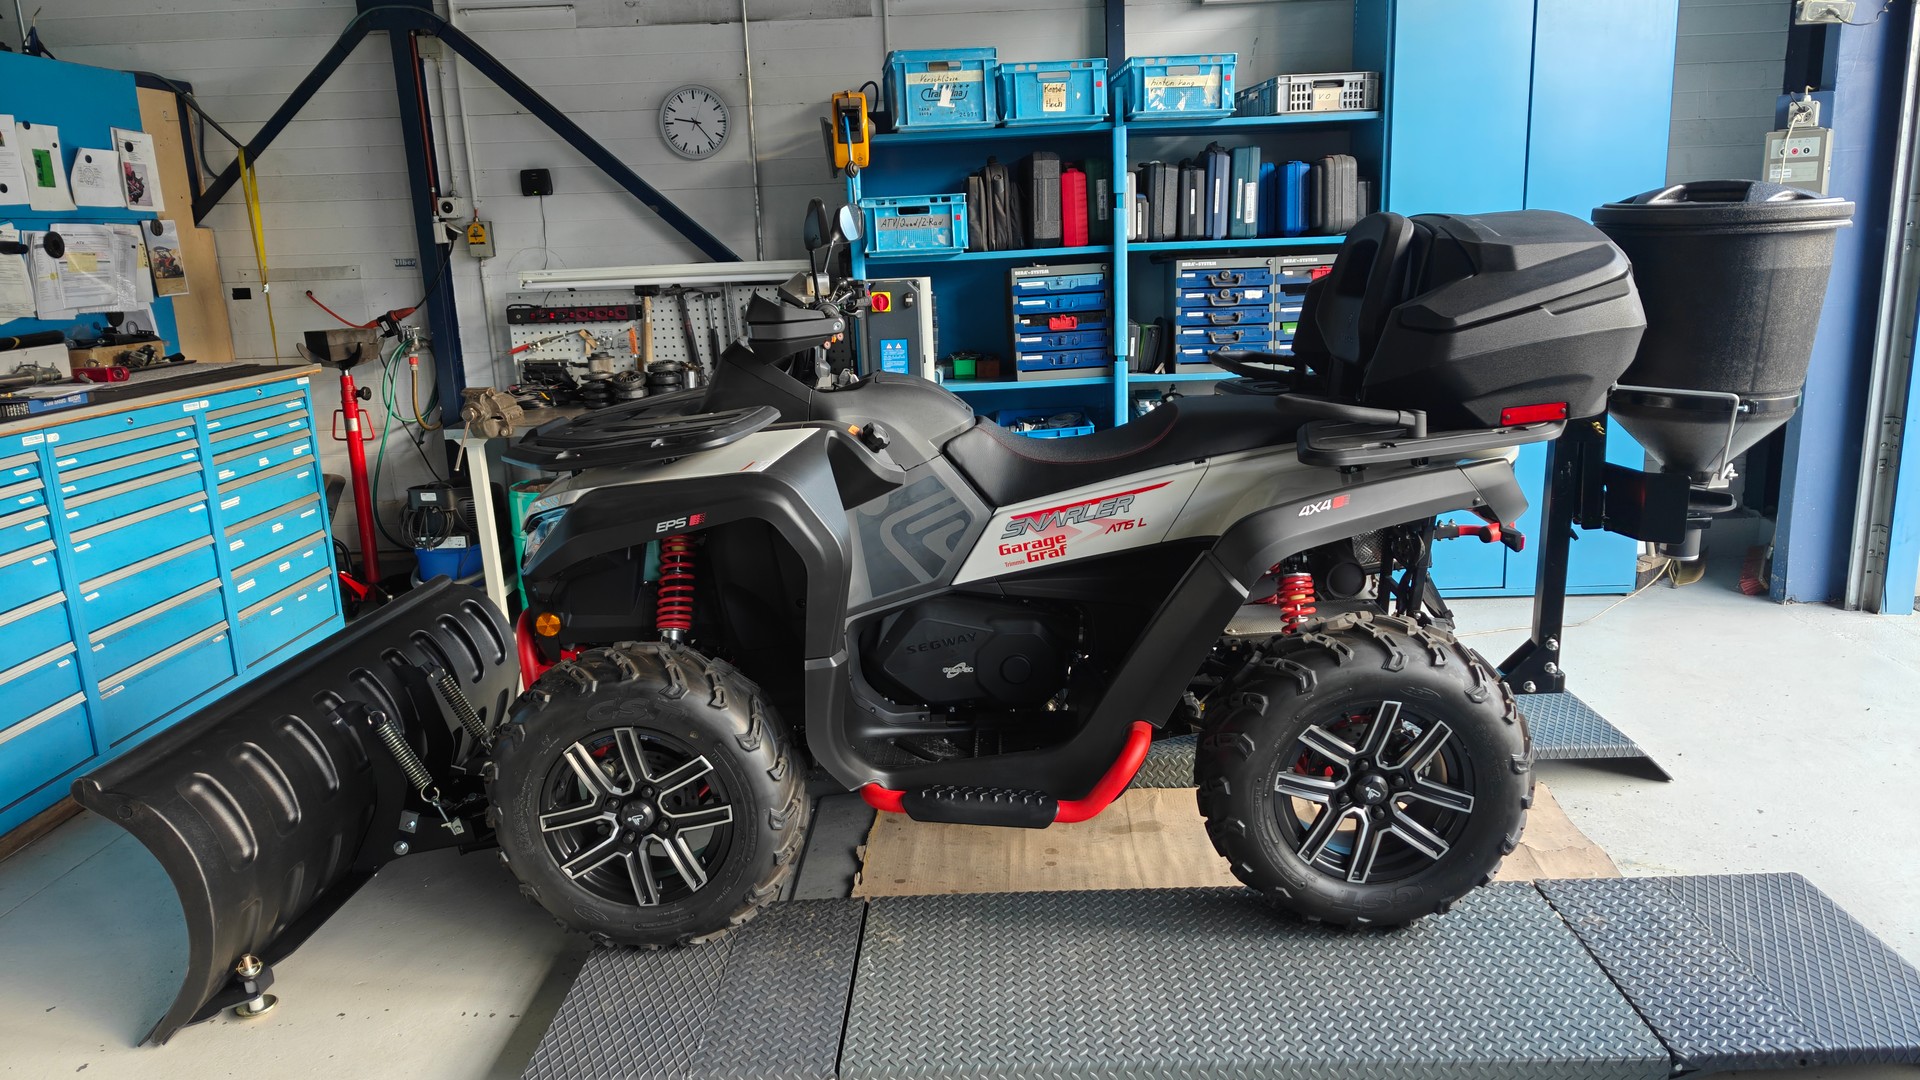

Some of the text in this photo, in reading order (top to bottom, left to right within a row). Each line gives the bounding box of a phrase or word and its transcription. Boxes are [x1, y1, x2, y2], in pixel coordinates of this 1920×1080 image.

[656, 517, 687, 533] EPS
[1000, 494, 1135, 540] SNARLER
[998, 534, 1067, 557] Garage
[1026, 543, 1067, 563] Graf
[906, 631, 977, 655] SEGWAY
